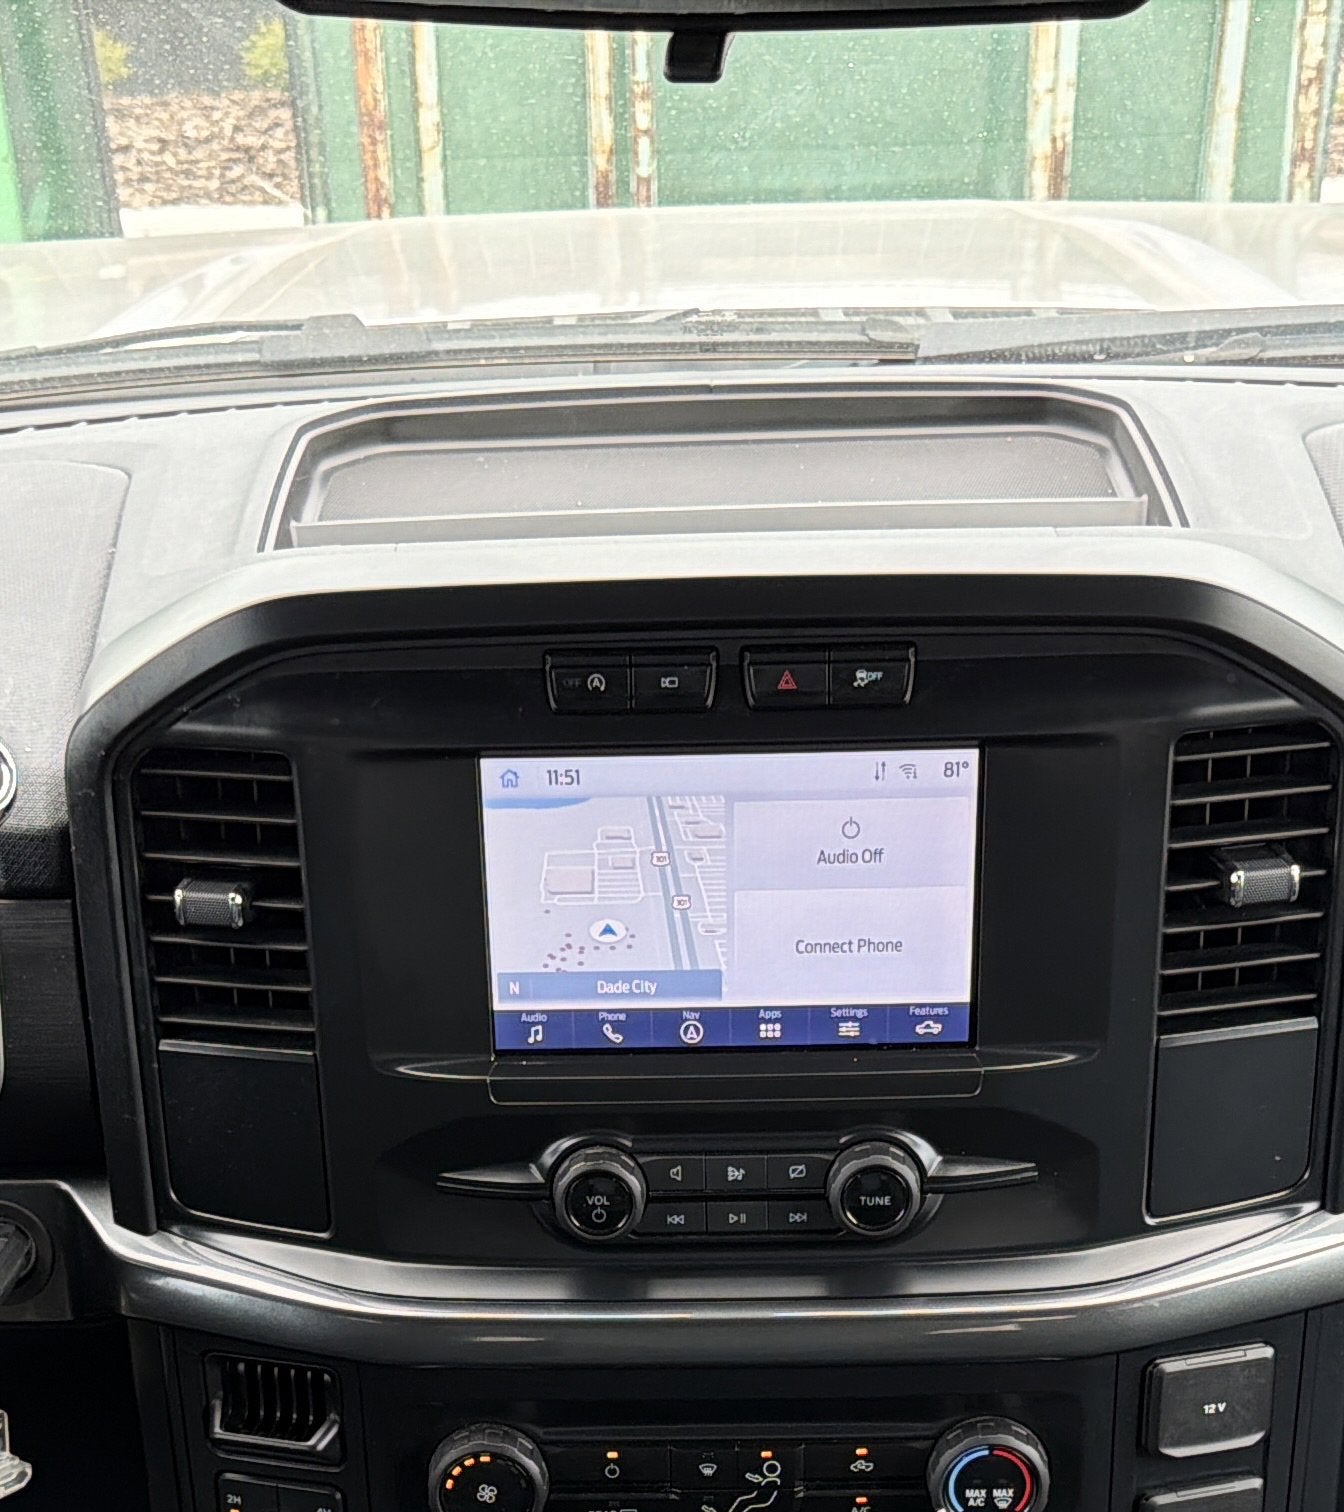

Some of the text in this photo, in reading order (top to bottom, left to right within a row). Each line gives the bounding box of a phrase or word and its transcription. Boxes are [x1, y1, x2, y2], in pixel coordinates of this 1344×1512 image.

[546, 769, 581, 787] 11:51
[817, 848, 885, 865] Audio Off
[795, 937, 903, 954] Connect Phone
[509, 980, 520, 994] N
[597, 979, 657, 996] Dade City
[598, 1011, 626, 1022] Phone
[683, 1010, 700, 1021] Nav
[758, 1009, 782, 1021] Apps
[830, 1007, 868, 1021] Settings
[909, 1005, 949, 1017] Features
[520, 1012, 547, 1023] Audio
[586, 1195, 610, 1207] VOL
[859, 1195, 892, 1207] TUNE
[1203, 1402, 1227, 1414] 12 V
[226, 1494, 242, 1504] 2H
[965, 1488, 987, 1498] MAX
[992, 1488, 1015, 1498] MAX
[968, 1498, 985, 1507] A/C
